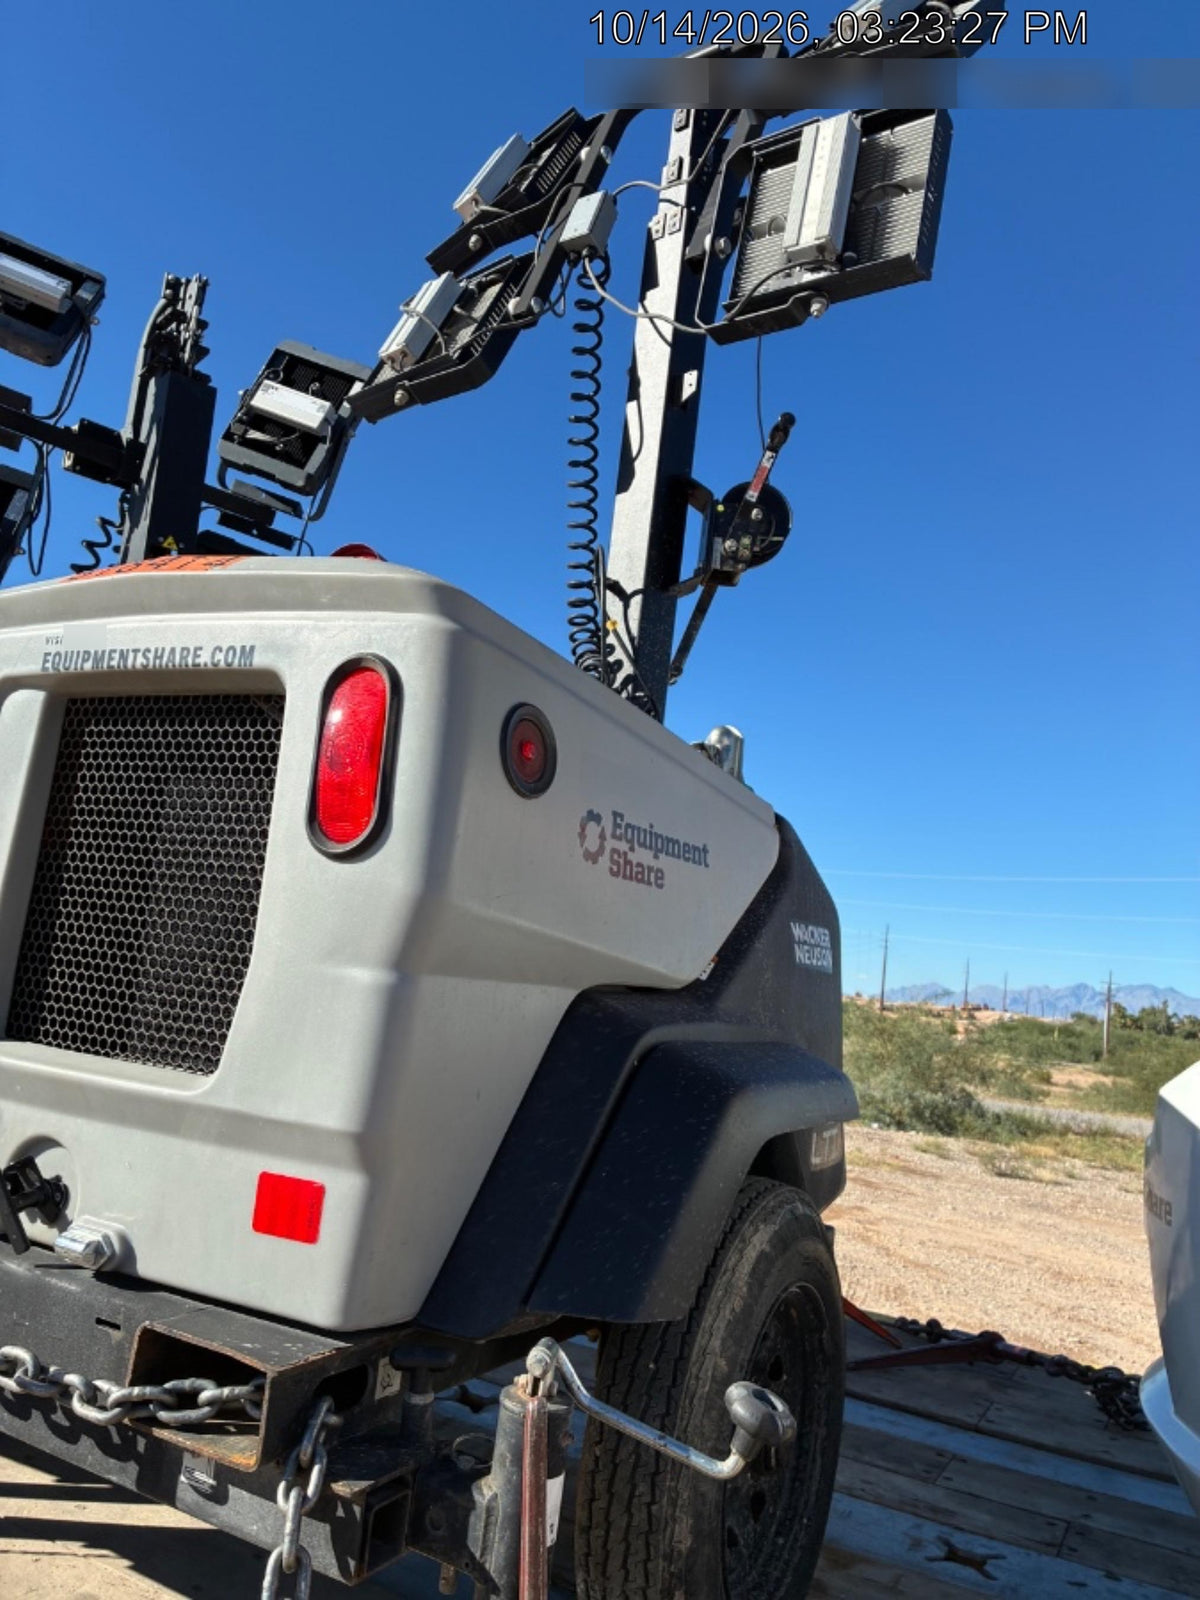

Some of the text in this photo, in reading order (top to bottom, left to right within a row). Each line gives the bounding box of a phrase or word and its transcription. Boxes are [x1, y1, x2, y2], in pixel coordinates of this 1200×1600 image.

[41, 645, 256, 672] EQUIPMENTSHARE.COM
[611, 810, 710, 868] Equipment
[609, 848, 665, 889] Share
[790, 921, 831, 948] WACKER
